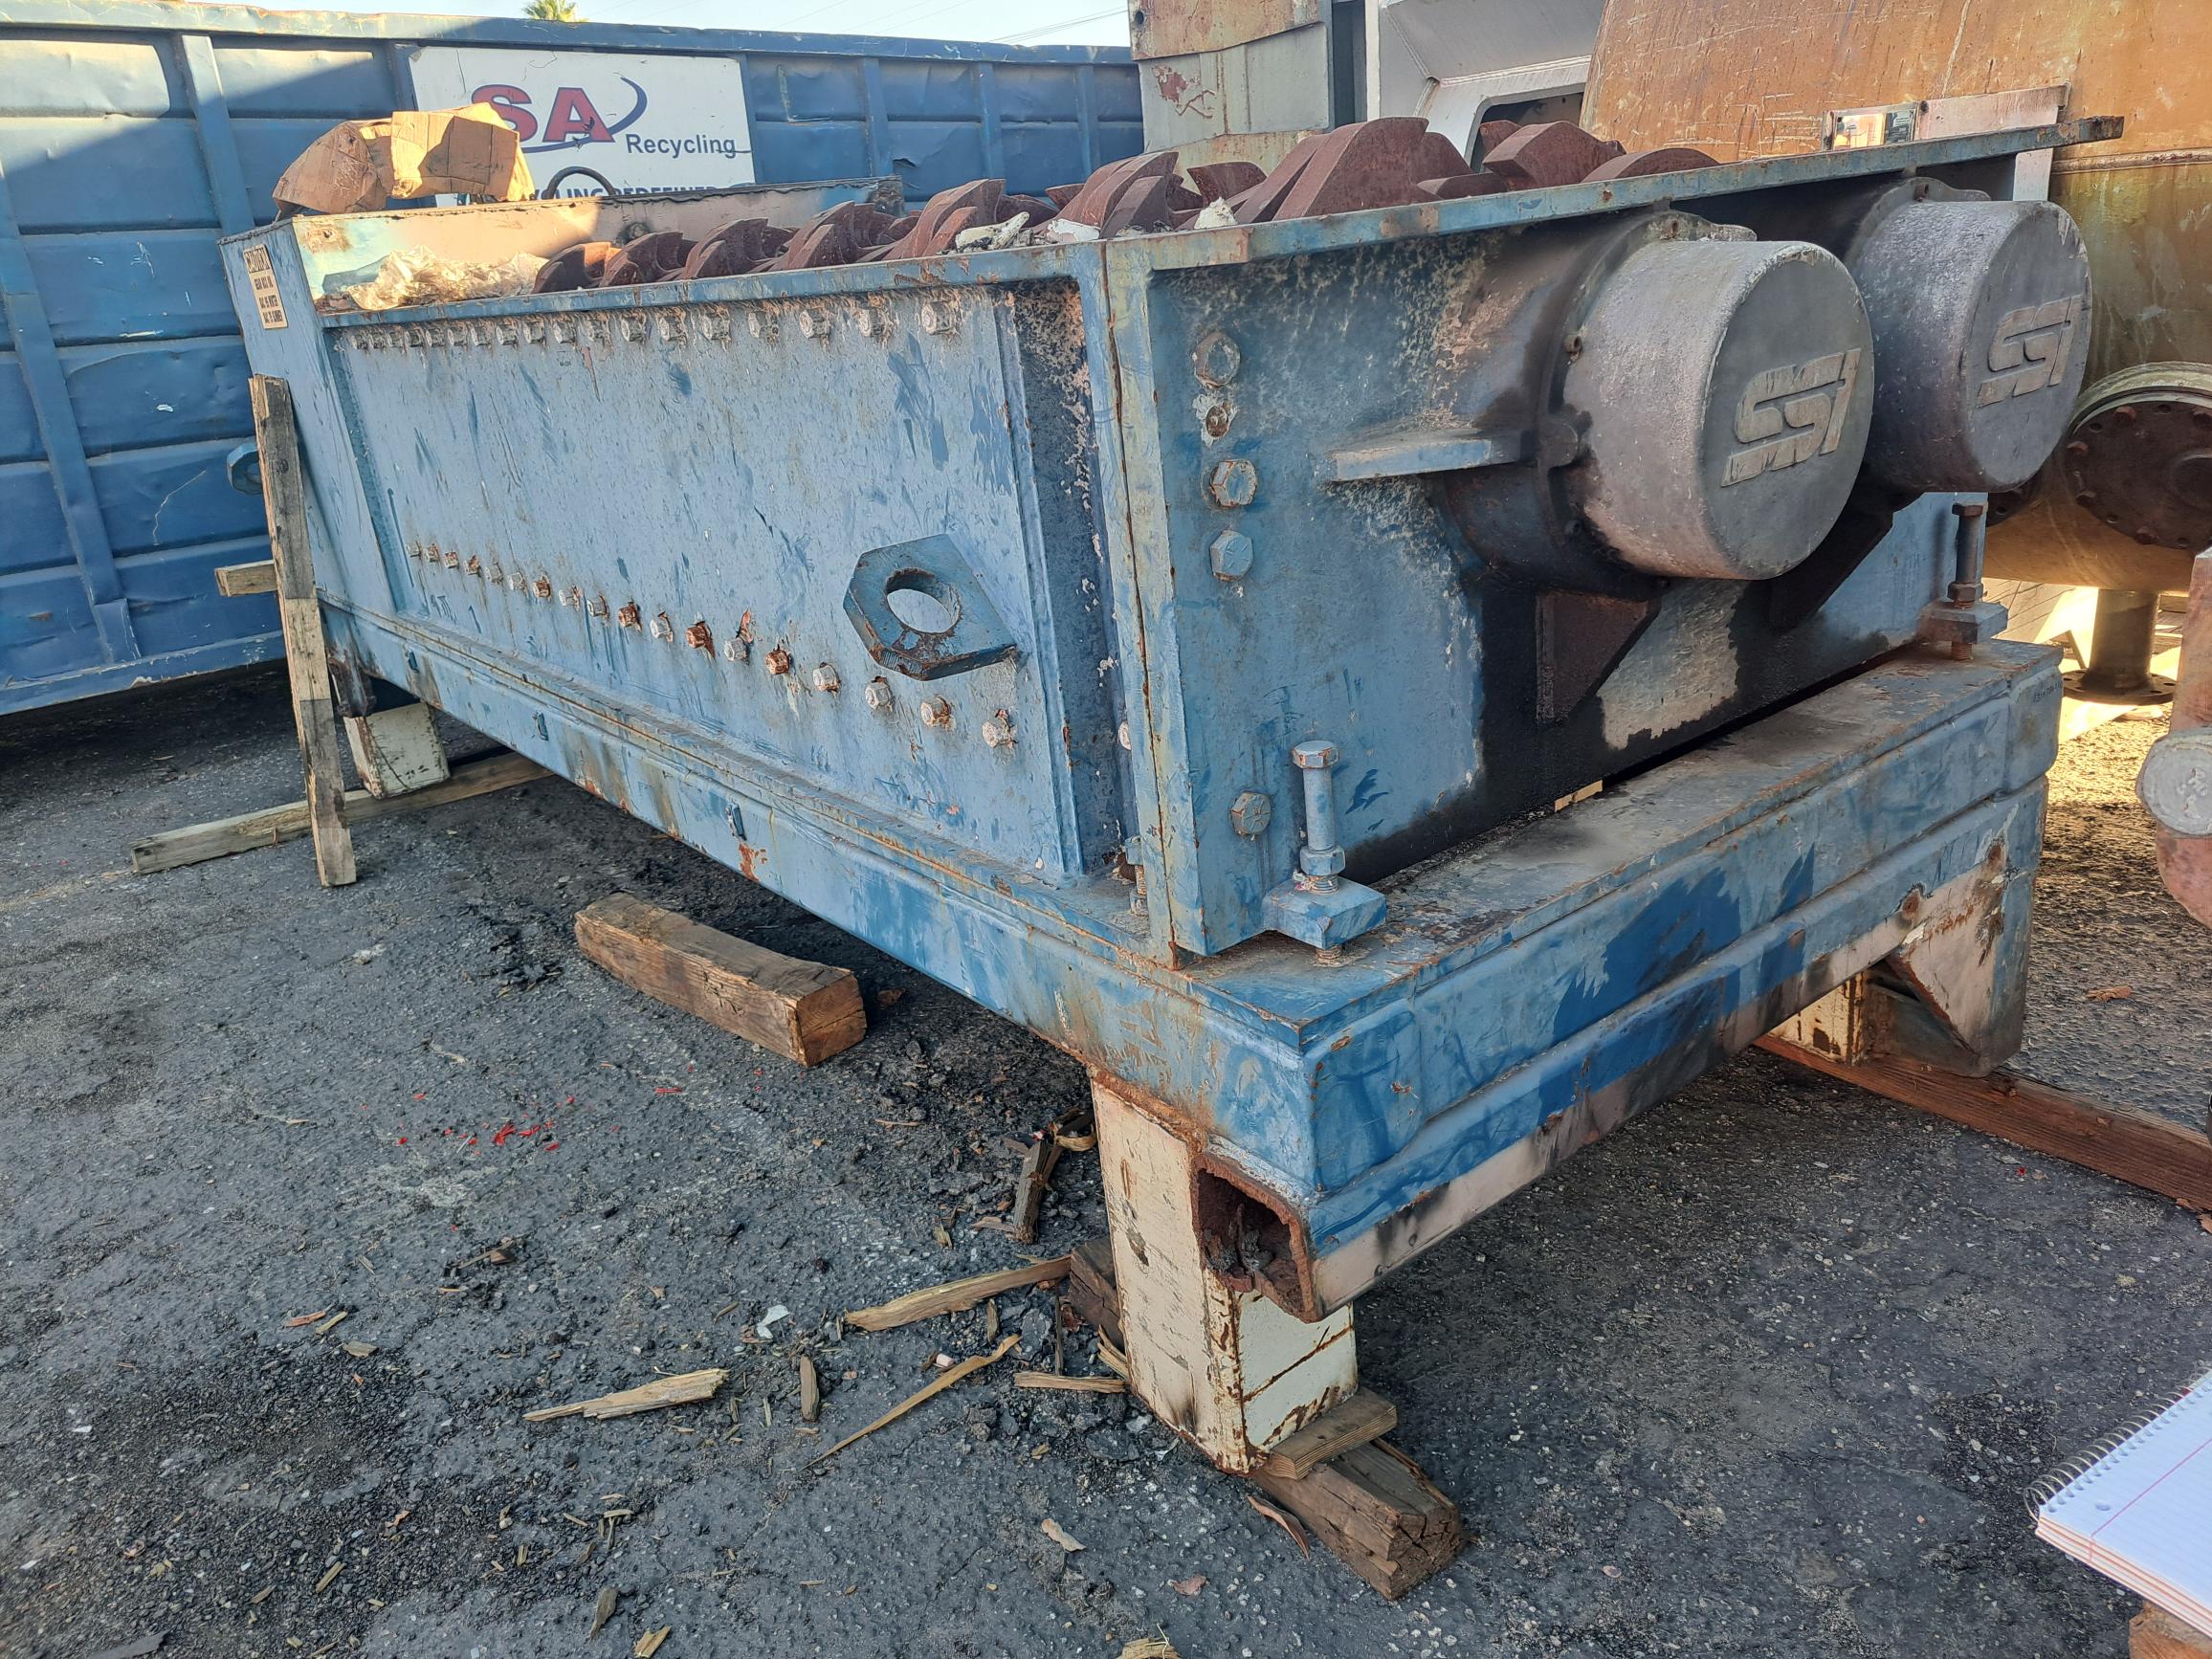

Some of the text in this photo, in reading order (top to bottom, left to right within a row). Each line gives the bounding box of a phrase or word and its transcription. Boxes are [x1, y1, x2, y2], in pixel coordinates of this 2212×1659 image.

[471, 84, 615, 143] SA
[627, 134, 737, 159] Recycling
[1976, 295, 2083, 409] SSI
[1721, 348, 1862, 487] SSI
